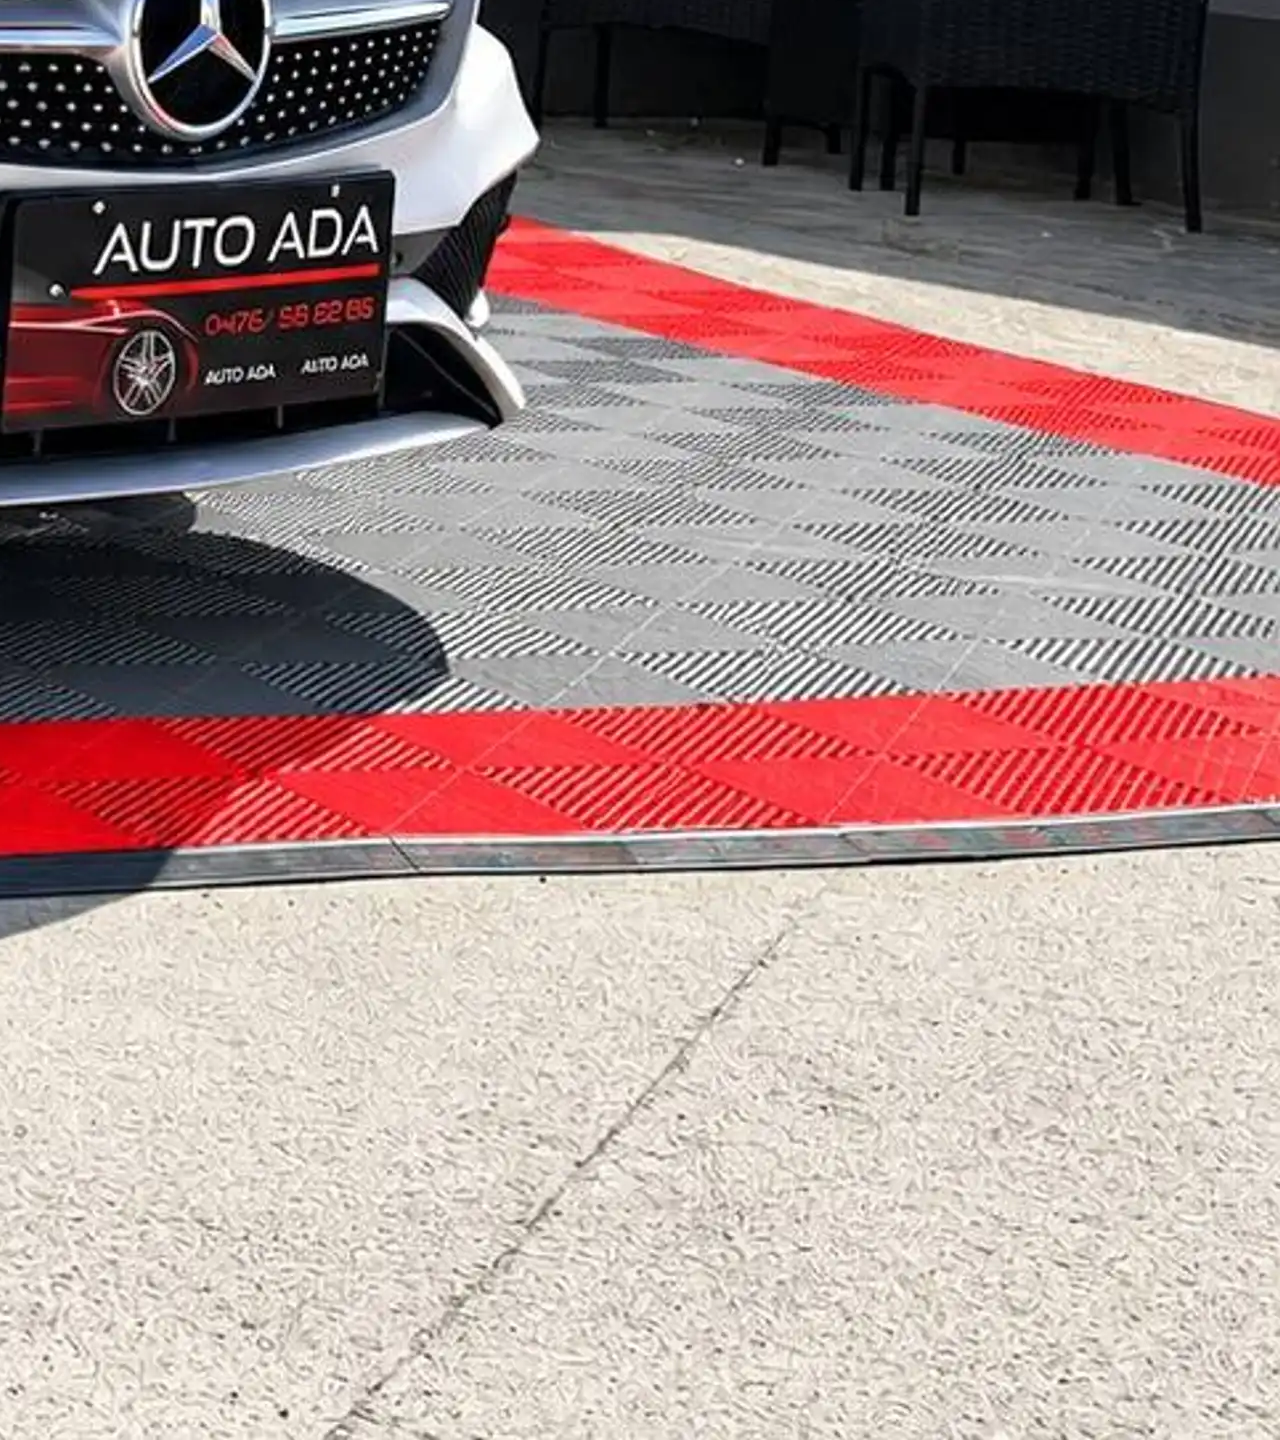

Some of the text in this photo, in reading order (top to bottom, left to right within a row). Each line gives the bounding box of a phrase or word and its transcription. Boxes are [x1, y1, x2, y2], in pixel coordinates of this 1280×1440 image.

[93, 205, 379, 275] AUTO ADA
[204, 363, 276, 385] AUTO ADA
[300, 355, 337, 374] AUTO
